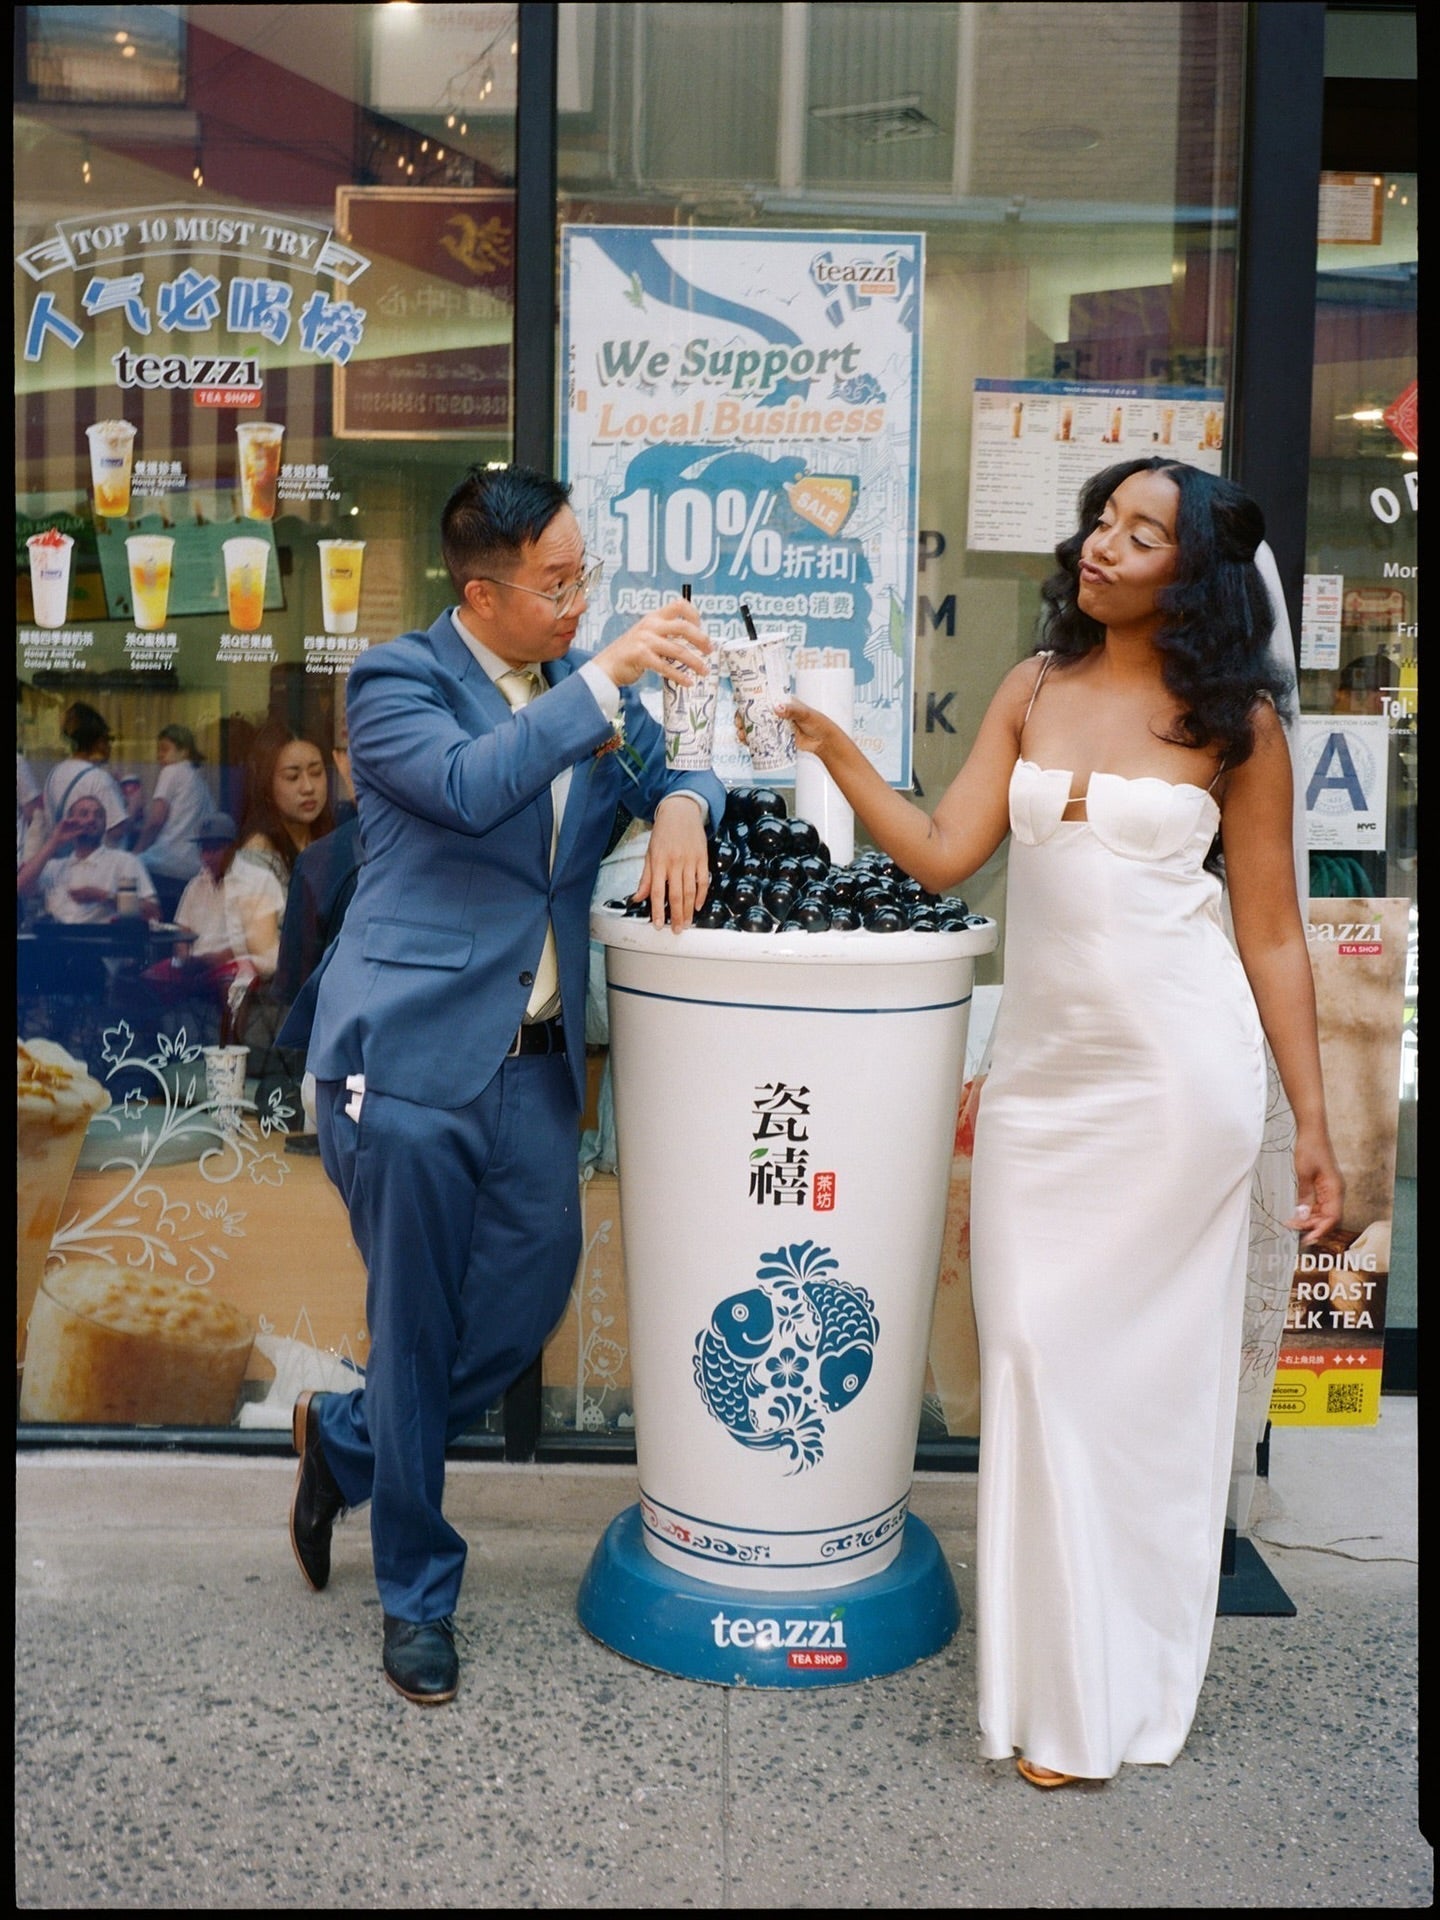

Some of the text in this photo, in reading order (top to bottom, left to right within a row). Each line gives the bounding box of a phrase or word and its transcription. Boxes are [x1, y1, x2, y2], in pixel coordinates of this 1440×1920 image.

[71, 217, 318, 259] TOP 10 MUST TRY
[817, 259, 896, 282] teazzi
[114, 347, 261, 388] teazzi
[600, 339, 671, 380] We
[679, 338, 861, 390] Support
[200, 390, 256, 404] TEA SHOP
[599, 399, 885, 438] Local Business
[797, 492, 839, 527] SALE
[614, 488, 850, 579] 10% 折扣
[618, 592, 657, 611] 凡在
[747, 594, 804, 614] Street
[1380, 696, 1413, 719] Tel:
[1305, 732, 1369, 812] A
[1357, 822, 1377, 830] NYC
[1342, 945, 1379, 953] TEA SHOP
[749, 1082, 812, 1206] 瓷禧
[816, 1175, 834, 1210] 茶坊
[1297, 1281, 1377, 1301] ROAST
[1329, 1310, 1375, 1329] TEA
[1273, 1386, 1299, 1394] elcome
[711, 1607, 847, 1648] teazzi
[791, 1653, 843, 1665] TEA SHOP
